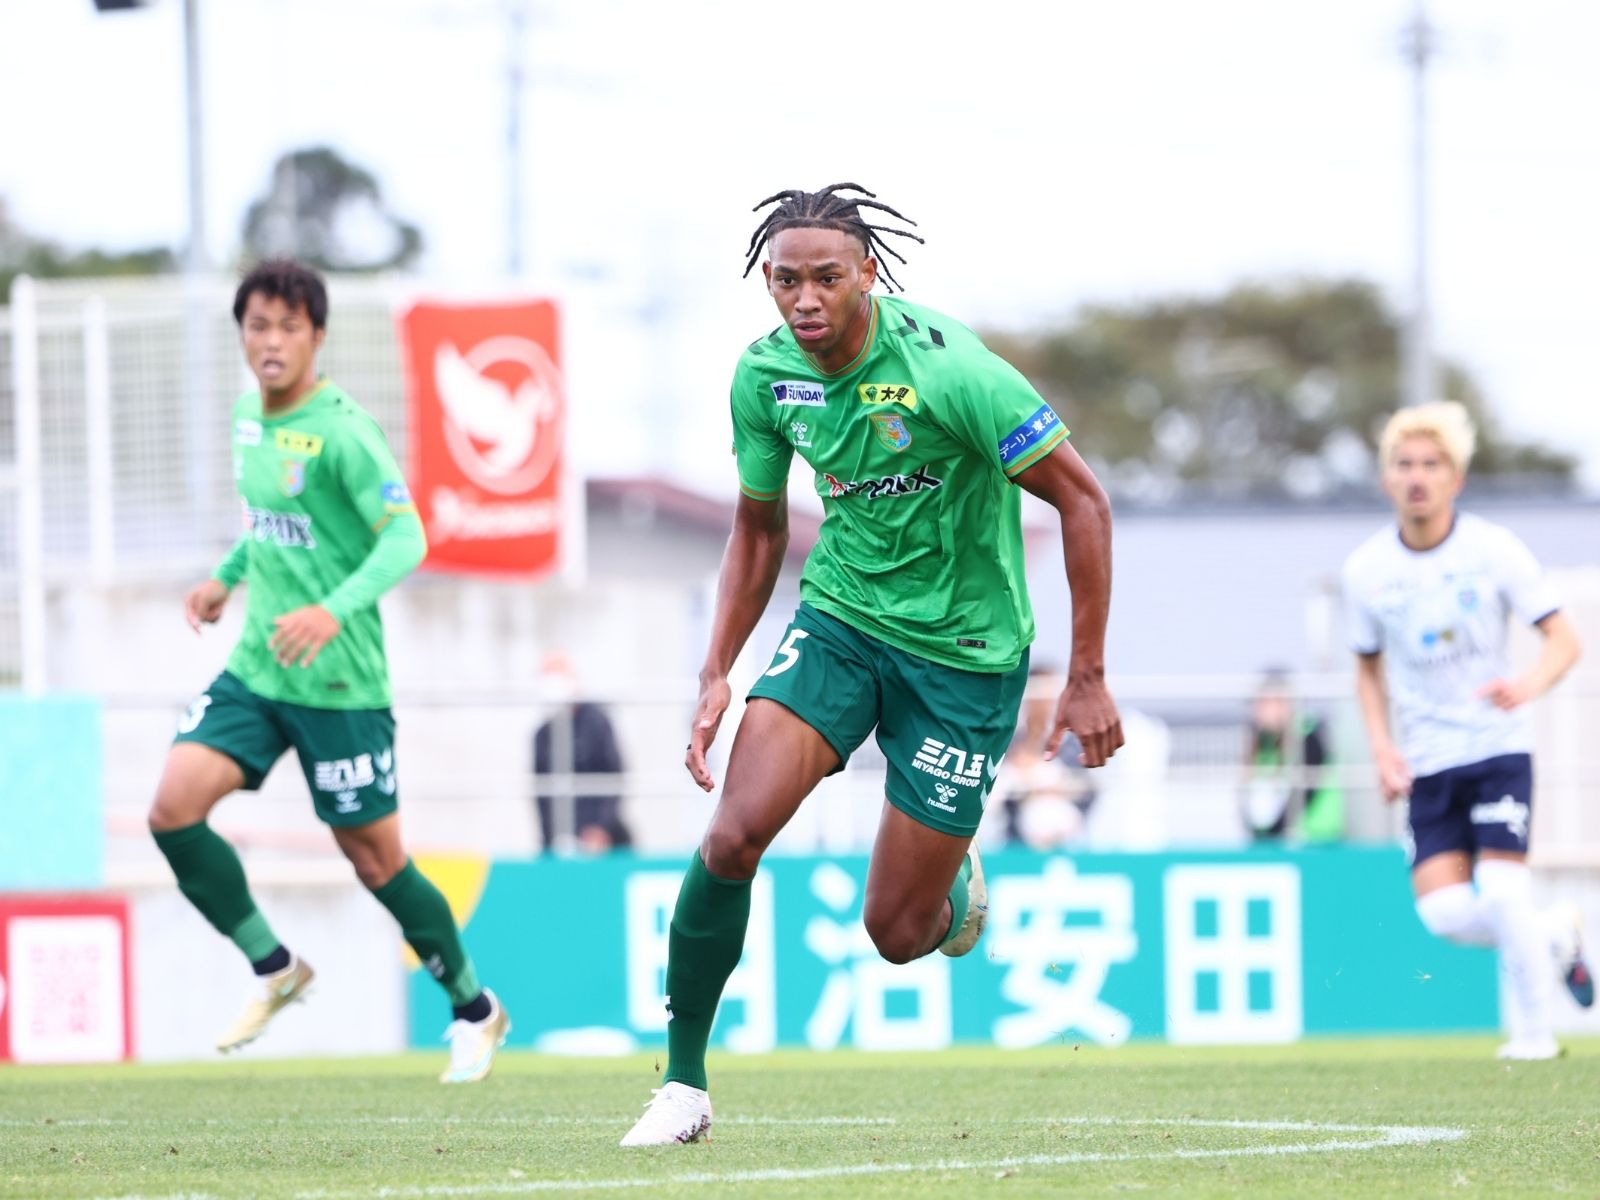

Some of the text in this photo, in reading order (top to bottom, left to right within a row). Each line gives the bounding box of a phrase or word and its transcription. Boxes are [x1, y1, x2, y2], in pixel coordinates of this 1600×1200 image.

[788, 389, 824, 402] SUNDAY
[1000, 411, 1056, 459] デーリー東北
[912, 759, 980, 788] MIYAGO GROUP
[928, 797, 957, 813] hummel
[625, 857, 1305, 1052] 明治安田
